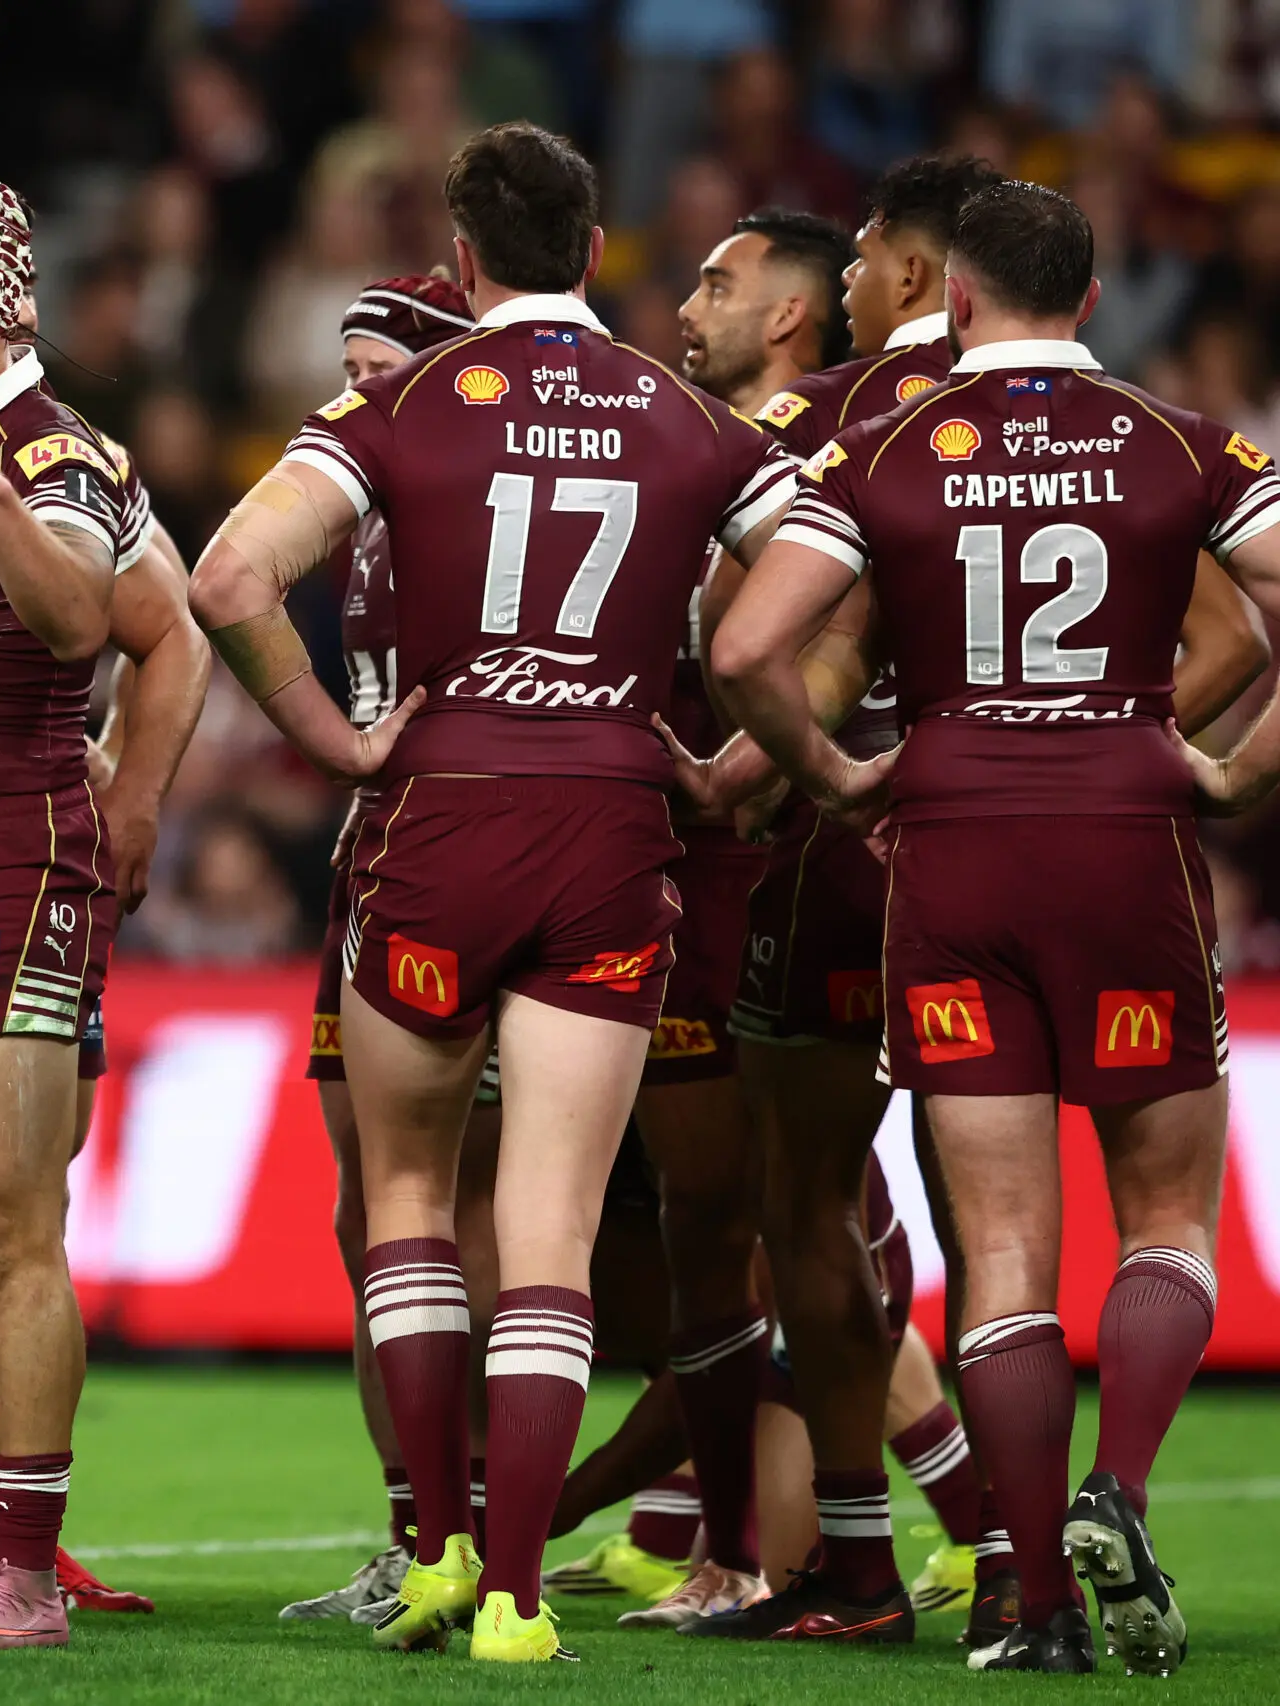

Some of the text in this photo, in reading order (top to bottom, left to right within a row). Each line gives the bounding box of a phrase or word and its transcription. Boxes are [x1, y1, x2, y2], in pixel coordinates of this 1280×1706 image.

[533, 383, 651, 410] V-Power
[505, 421, 622, 460] LOIERO
[1002, 436, 1125, 458] V-Power
[943, 468, 1124, 508] CAPEWELL
[485, 471, 638, 639] 17
[955, 523, 1110, 685] 12
[446, 646, 638, 708] Ford
